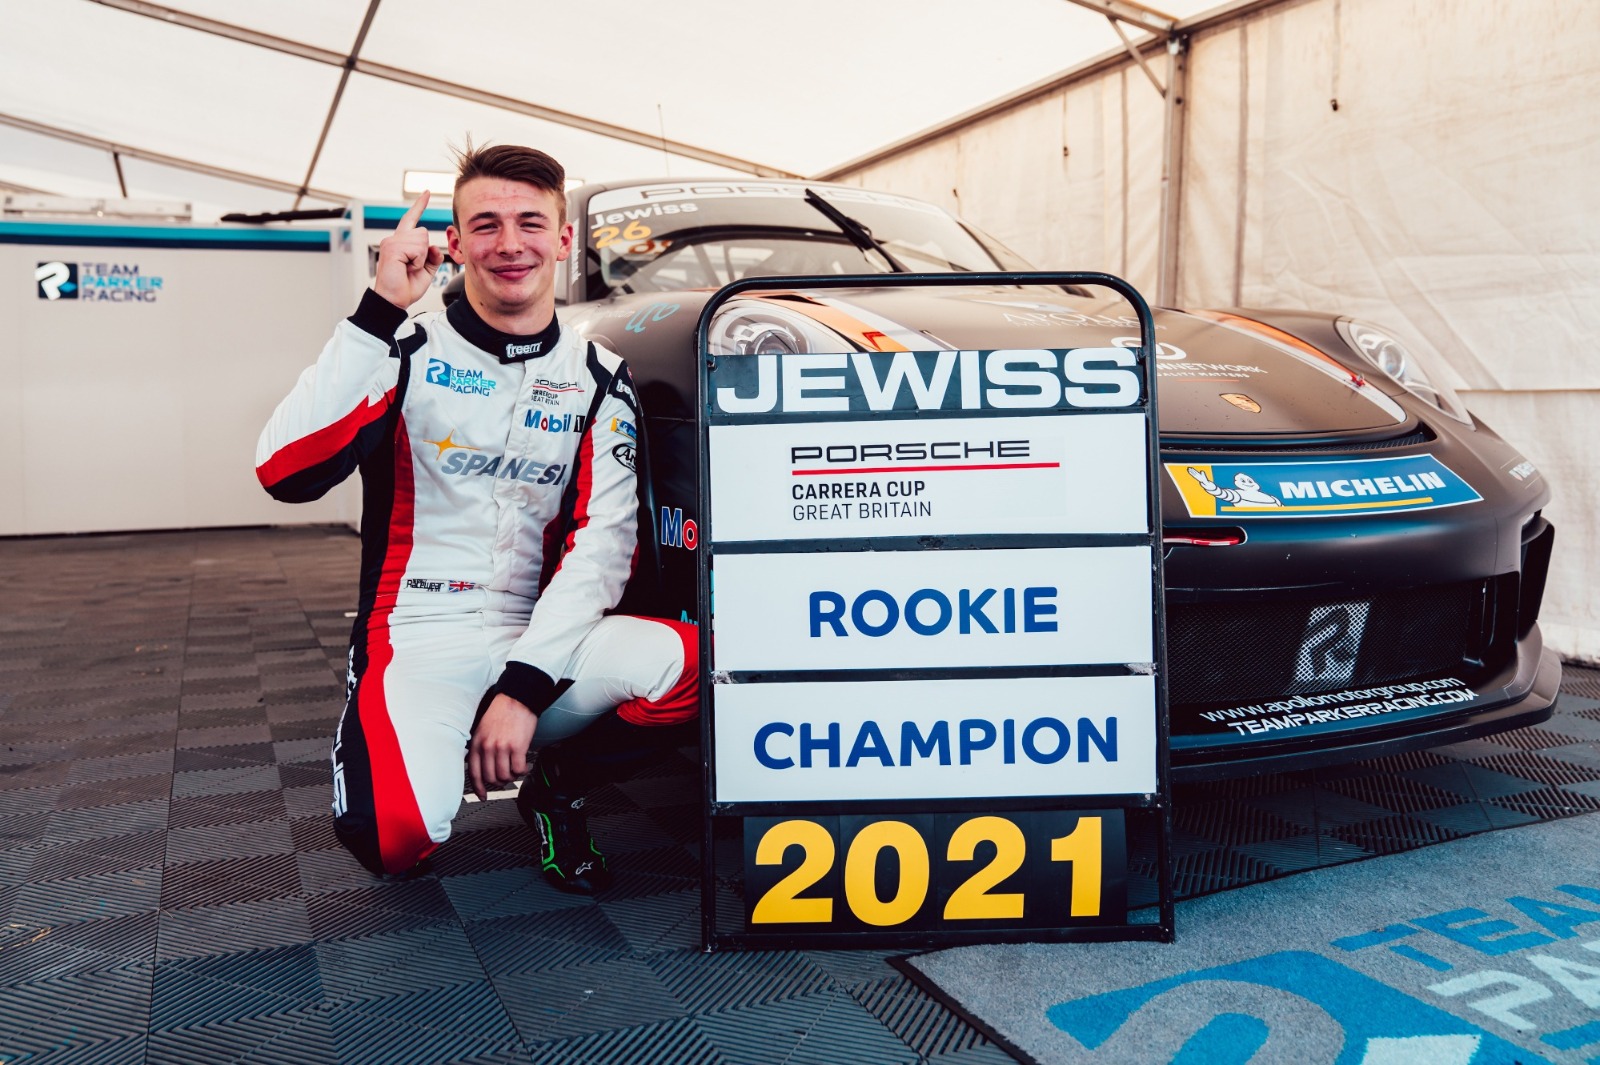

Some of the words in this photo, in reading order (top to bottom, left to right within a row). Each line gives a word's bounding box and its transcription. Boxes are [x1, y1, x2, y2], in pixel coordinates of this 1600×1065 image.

[590, 203, 699, 230] Jewiss
[592, 219, 651, 249] 26
[82, 263, 140, 276] TEAM
[82, 276, 163, 290] PARKER
[82, 289, 156, 302] RACING
[506, 342, 542, 358] freem
[451, 367, 483, 379] TEAM
[451, 375, 497, 390] PARKER
[716, 348, 1140, 413] JEWISS
[450, 381, 490, 397] RACING
[525, 409, 572, 432] Mobil
[791, 439, 1030, 464] PORSCHE
[441, 452, 568, 486] SPANESI
[791, 482, 882, 500] CARRERA
[886, 480, 926, 498] CUP
[1279, 470, 1447, 499] MICHELIN
[792, 502, 853, 521] GREAT
[858, 500, 932, 519] BRITAIN
[808, 586, 1059, 638] ROOKIE
[1199, 676, 1466, 723] www.apollomotorgroup.com
[1227, 688, 1479, 736] TEAMPARKERRACING.COM
[753, 716, 1118, 770] CHAMPION
[751, 816, 1102, 927] 2021
